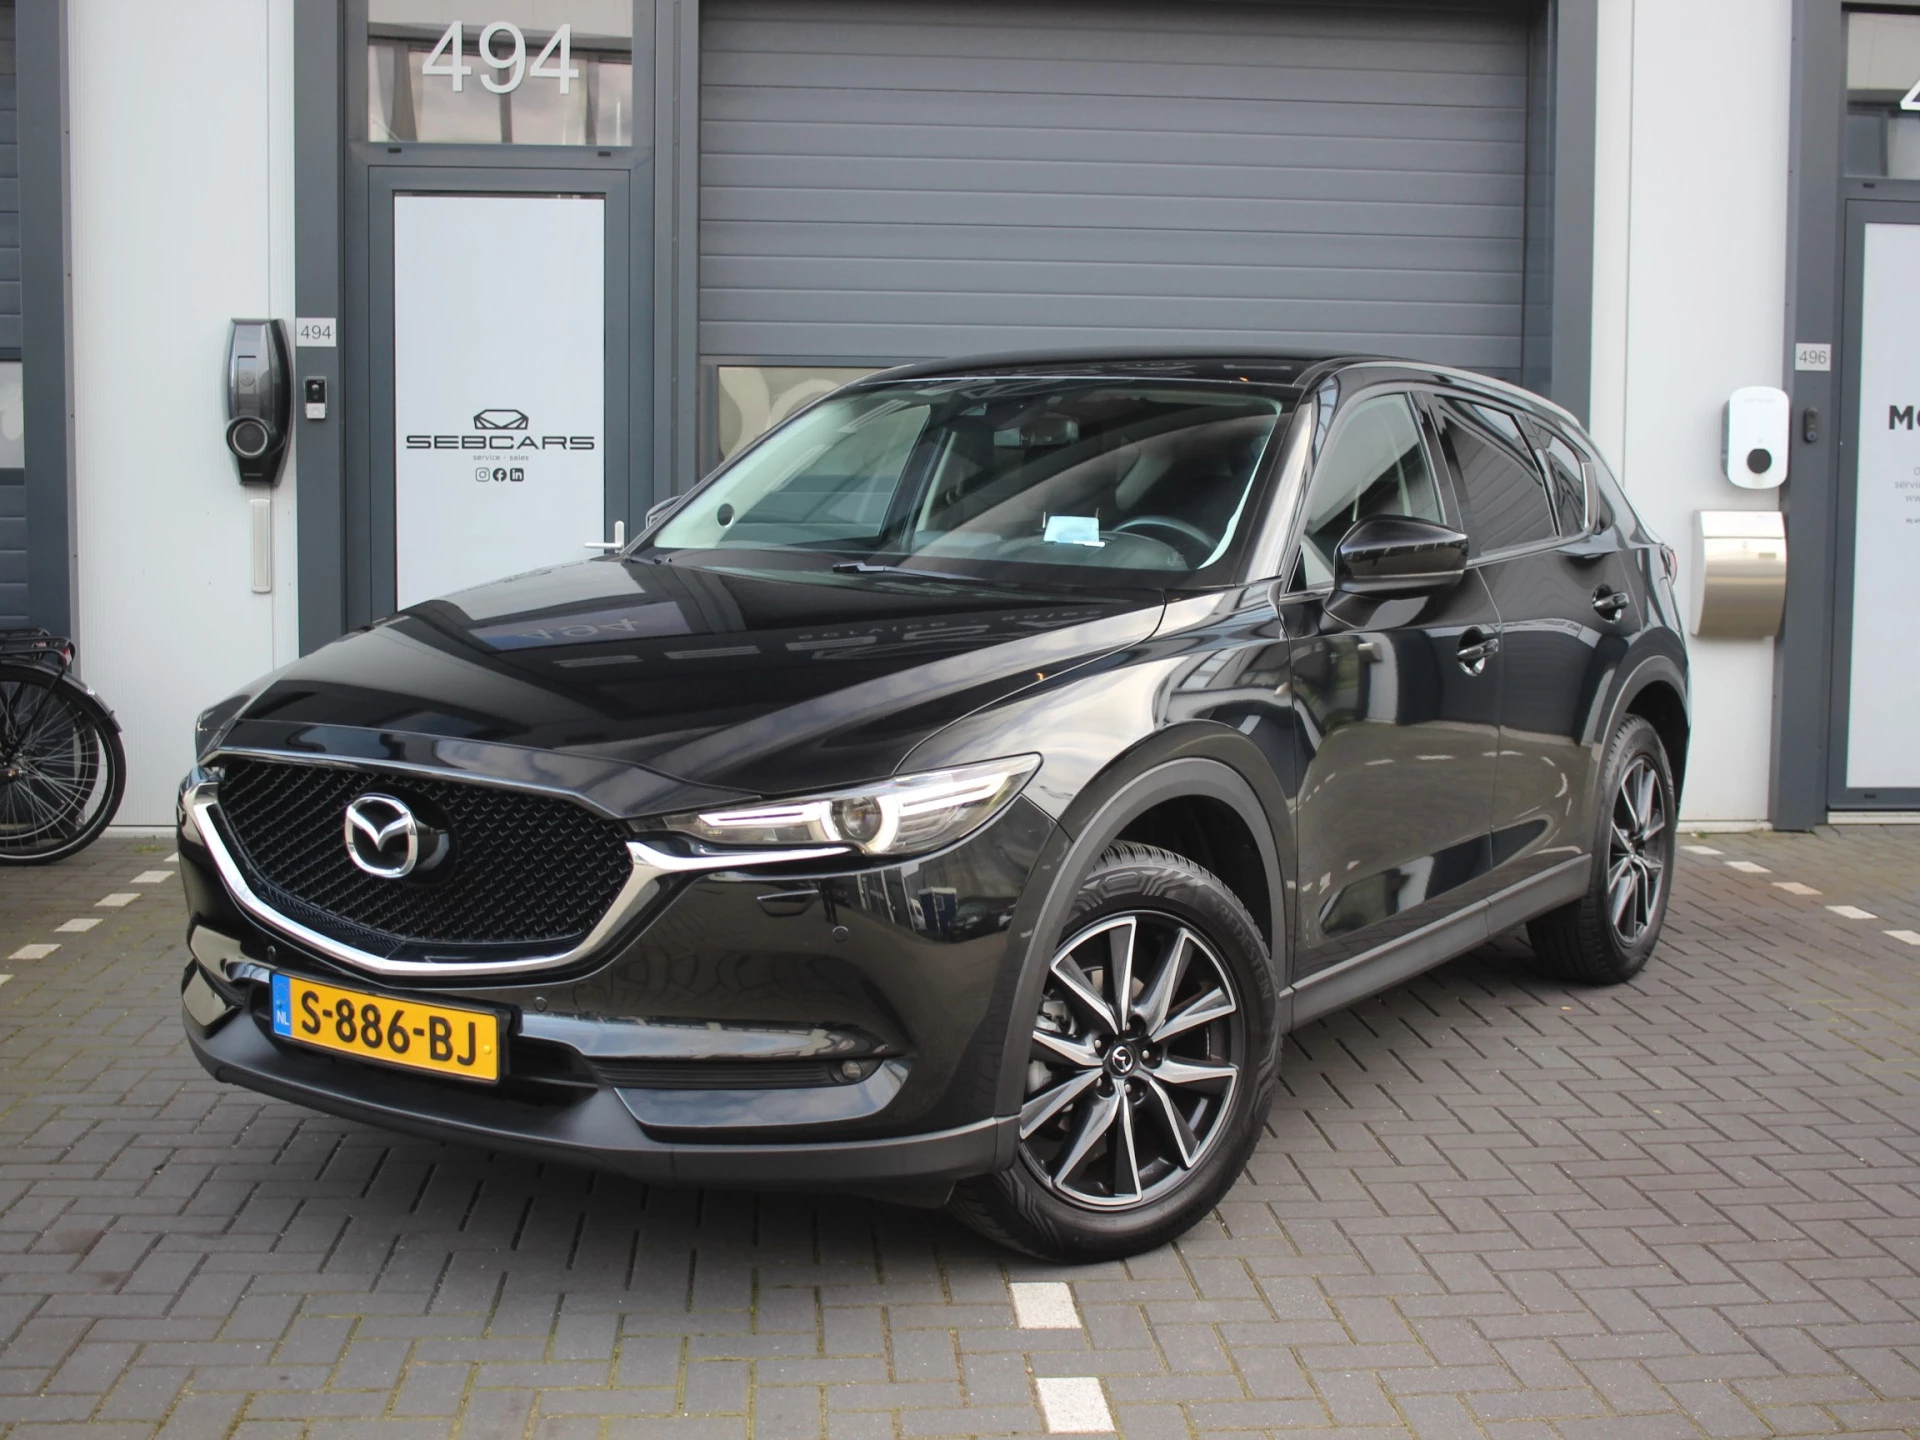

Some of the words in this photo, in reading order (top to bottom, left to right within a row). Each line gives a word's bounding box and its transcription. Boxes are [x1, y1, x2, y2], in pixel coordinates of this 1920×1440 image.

[422, 20, 579, 94] 494
[300, 324, 332, 340] 494
[1799, 350, 1827, 365] 496
[1889, 405, 1920, 430] M
[406, 435, 595, 450] SEBCARS
[472, 454, 501, 462] service
[509, 454, 530, 462] sales
[276, 1010, 290, 1026] NL
[301, 990, 476, 1066] S-886-BJ
